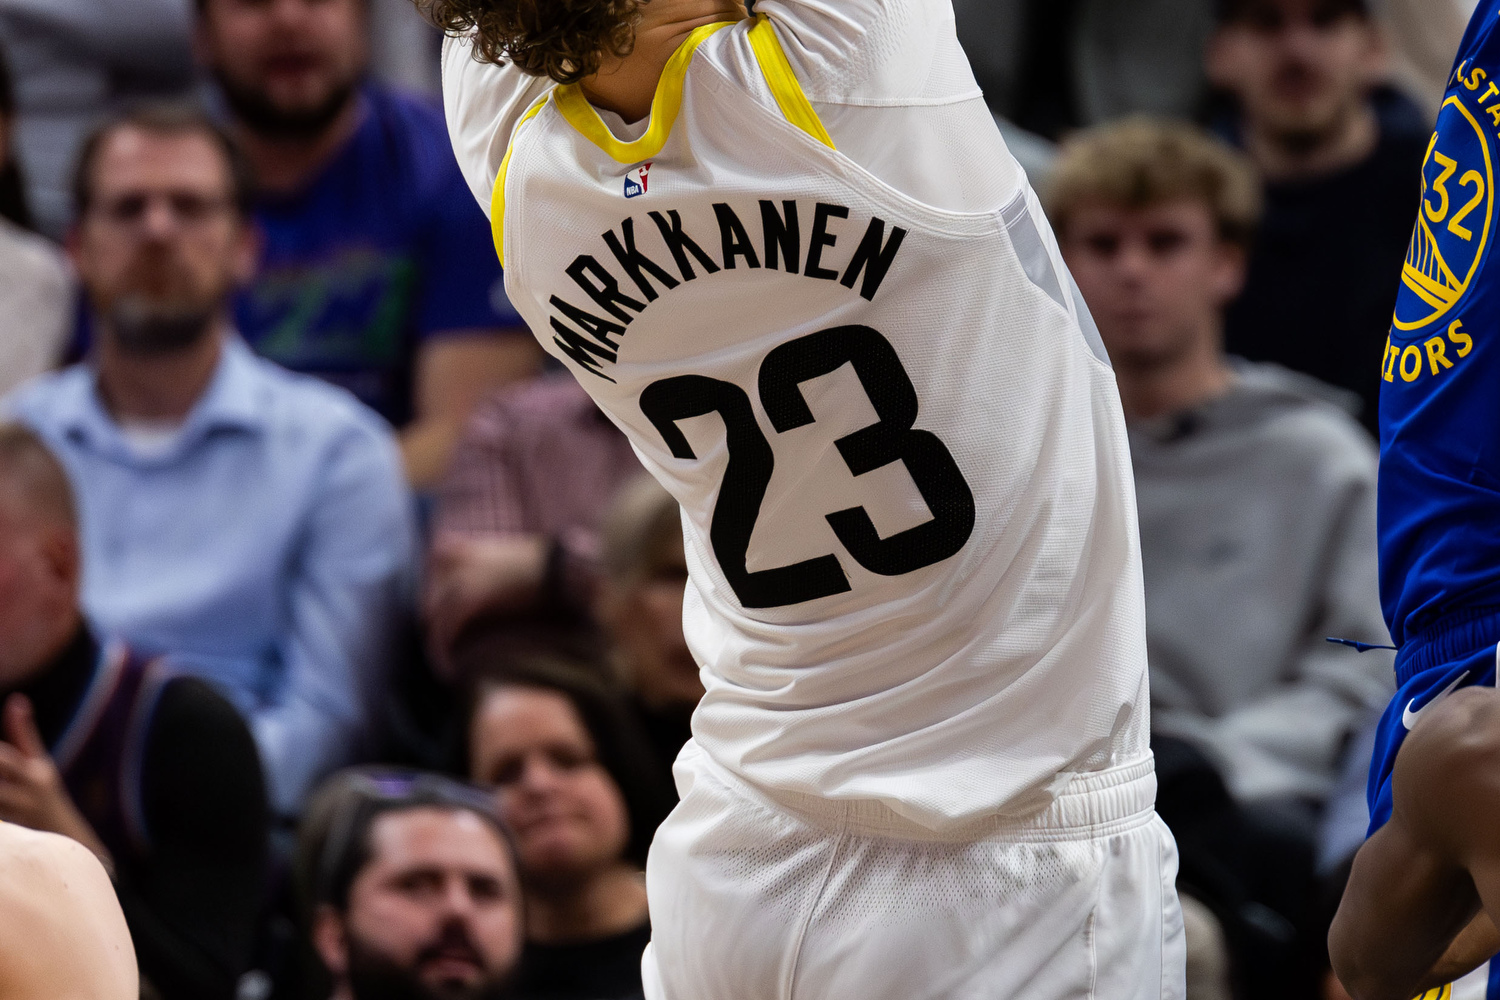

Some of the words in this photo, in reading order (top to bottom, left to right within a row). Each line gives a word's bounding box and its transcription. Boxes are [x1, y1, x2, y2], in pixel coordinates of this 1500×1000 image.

[626, 184, 640, 197] NBA
[1424, 150, 1485, 241] 32
[549, 199, 909, 384] MARKKANEN
[1382, 318, 1474, 383] IORS
[639, 324, 976, 608] 23
